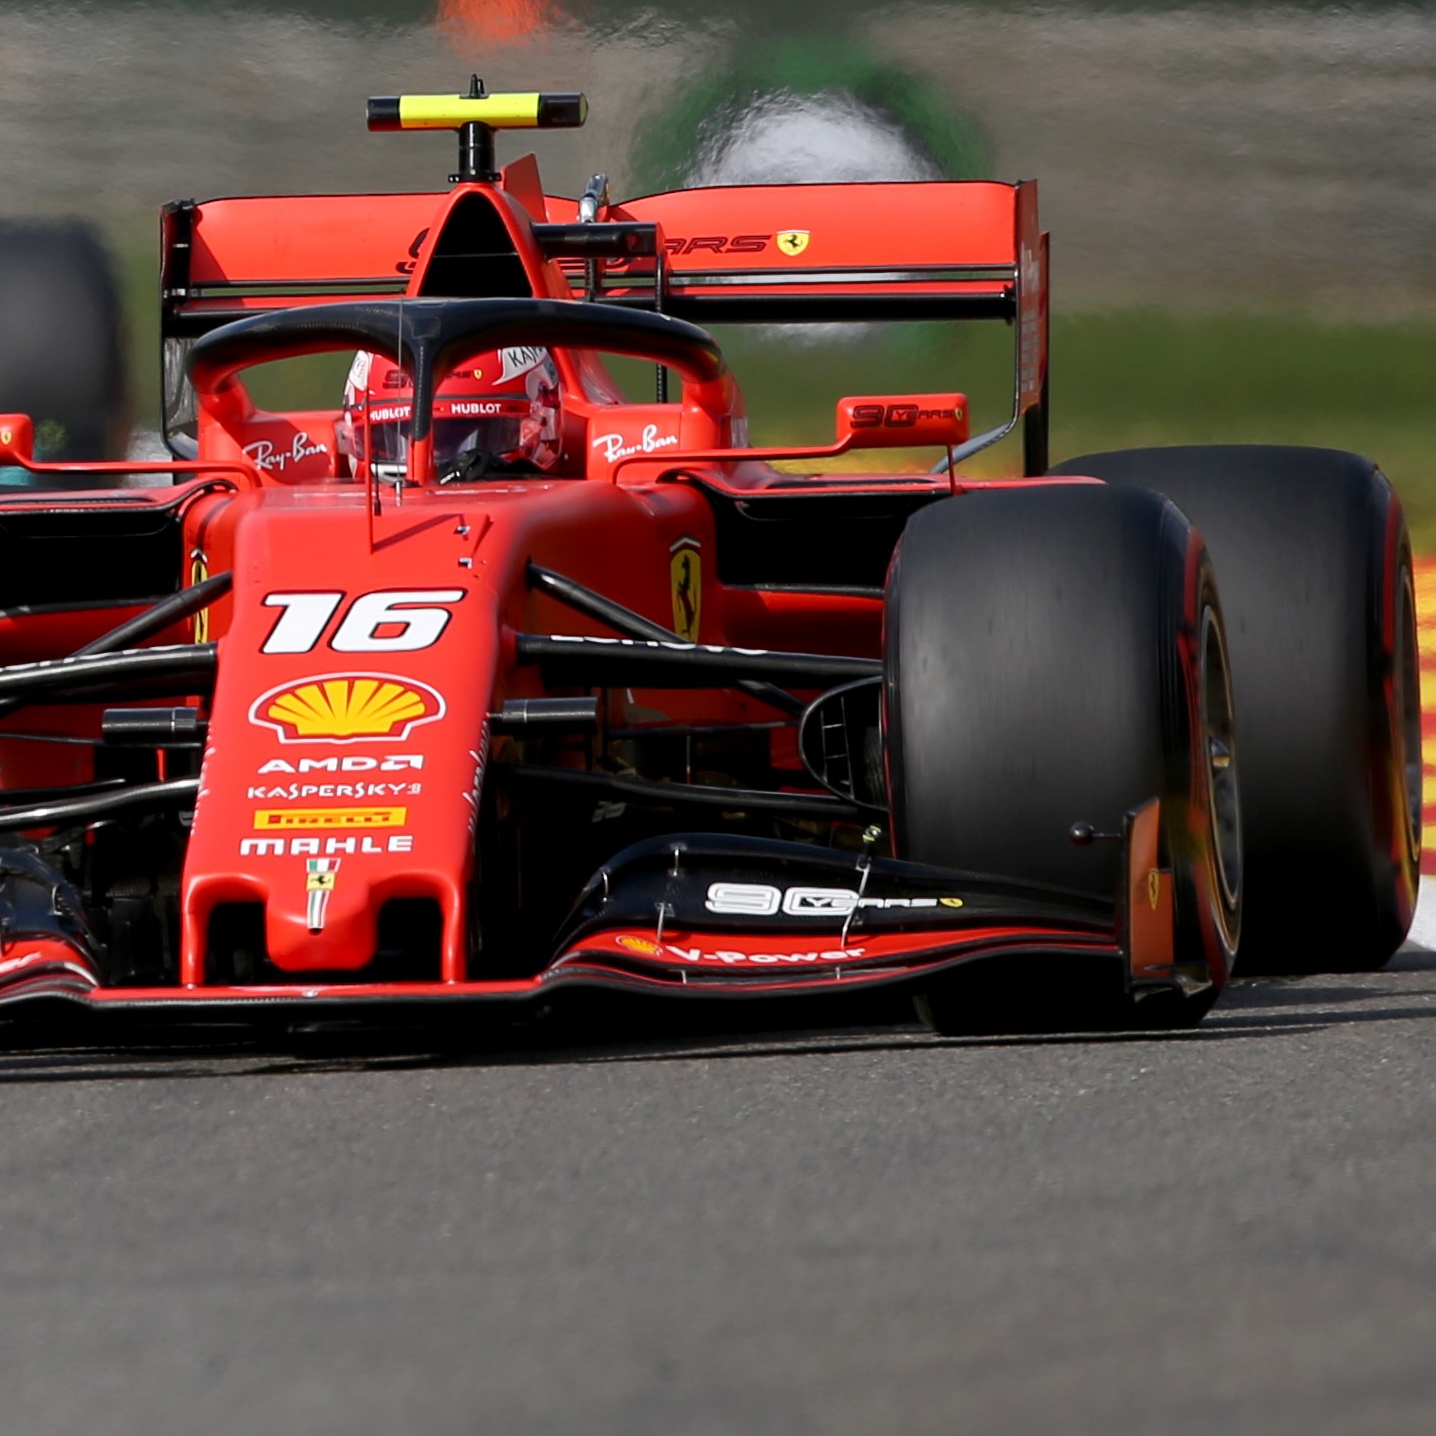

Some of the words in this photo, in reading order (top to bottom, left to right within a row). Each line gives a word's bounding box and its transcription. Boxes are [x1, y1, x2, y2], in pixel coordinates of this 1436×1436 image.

[451, 404, 502, 414] HUBLOT
[242, 432, 328, 470] Ray-Ban
[260, 589, 467, 654] 16
[247, 782, 407, 800] KASPERSKY
[239, 835, 414, 856] MAHLE
[665, 944, 866, 964] V-Power
